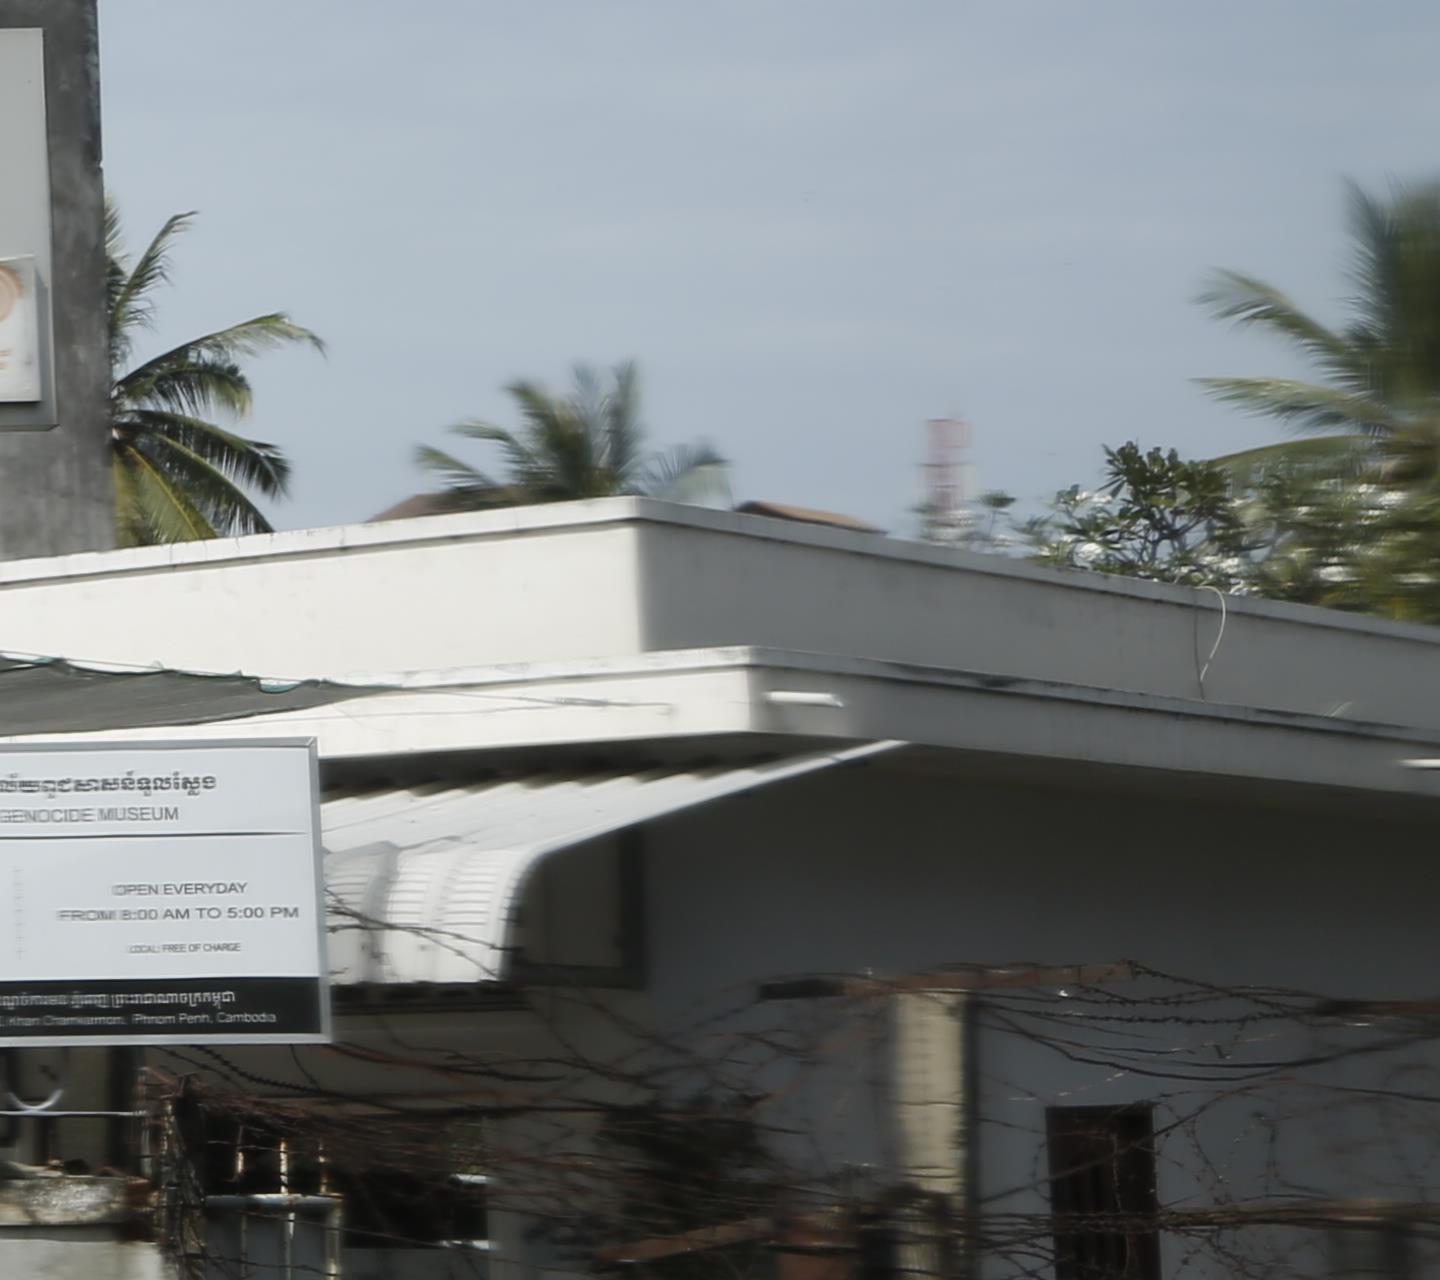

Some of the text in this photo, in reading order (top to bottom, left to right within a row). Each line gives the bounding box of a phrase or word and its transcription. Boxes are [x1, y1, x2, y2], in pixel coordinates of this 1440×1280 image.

[98, 806, 180, 822] MUSEUM
[112, 882, 248, 897] OPEN EVERYDAY
[163, 908, 191, 920] AM
[195, 907, 222, 919] TO
[226, 906, 265, 919] 5:00
[270, 906, 300, 918] PM
[162, 943, 187, 953] FREE
[188, 943, 202, 953] OF
[203, 942, 241, 952] CHARGE
[216, 1011, 278, 1023] Cambodia
